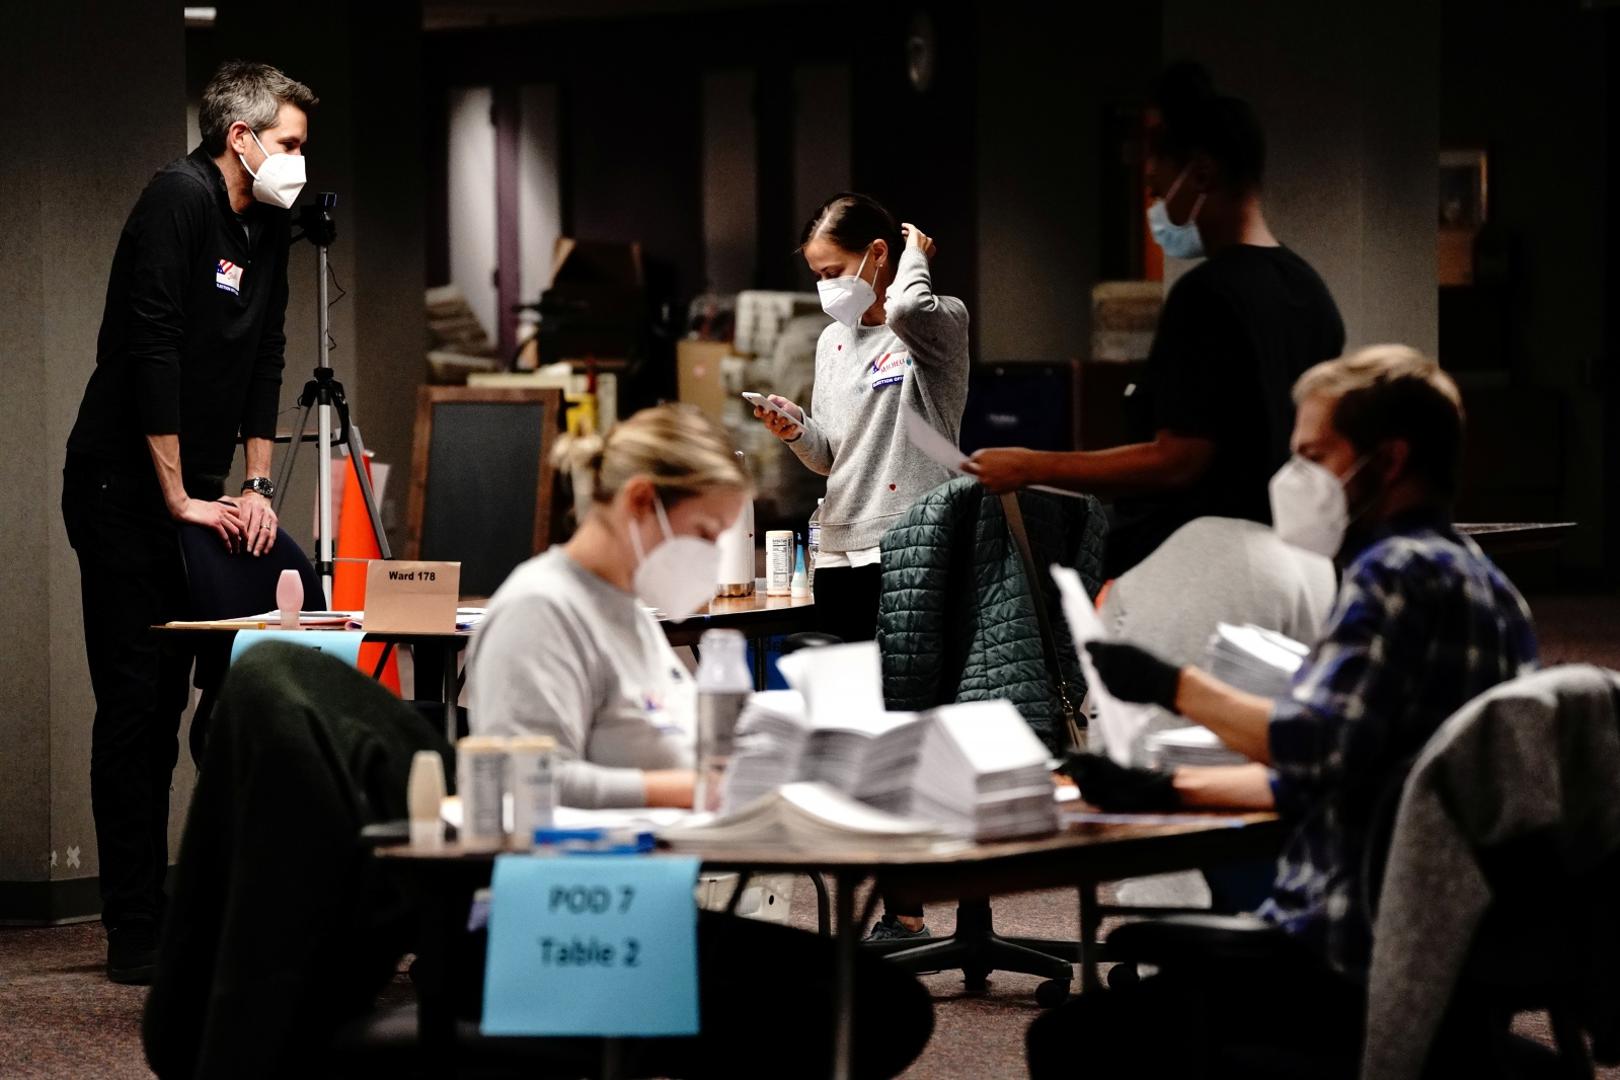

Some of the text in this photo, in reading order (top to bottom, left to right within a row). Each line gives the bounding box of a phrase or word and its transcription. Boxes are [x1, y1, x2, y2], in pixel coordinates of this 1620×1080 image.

[389, 571, 436, 581] Ward 178
[548, 885, 636, 915] POD 7
[538, 935, 642, 968] Table 2
